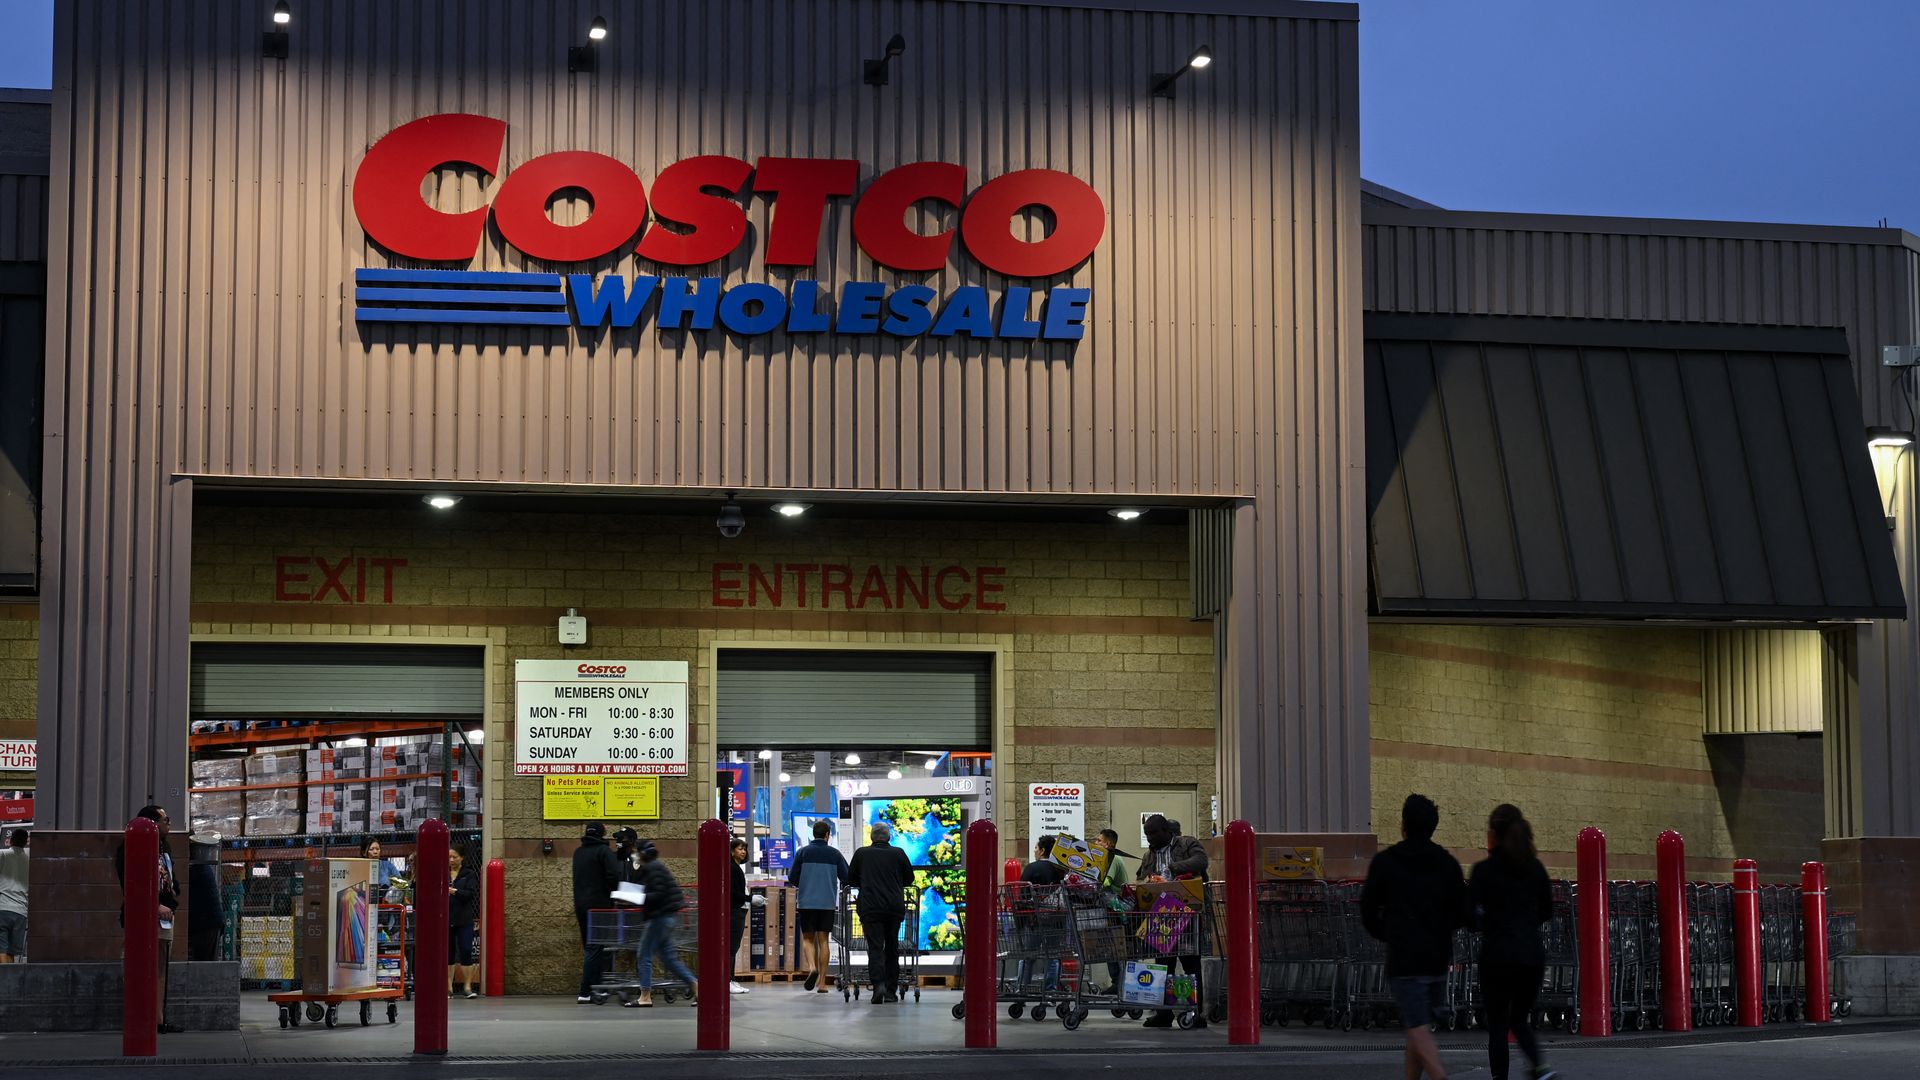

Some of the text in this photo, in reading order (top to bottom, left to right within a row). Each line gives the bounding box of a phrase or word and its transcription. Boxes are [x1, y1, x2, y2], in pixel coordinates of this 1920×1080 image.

[353, 113, 1105, 277] COSTCO
[566, 274, 1091, 339] WHOLESALE
[275, 556, 408, 603] EXIT
[712, 562, 1006, 611] ENTRANCE
[578, 664, 627, 674] COSTCO
[554, 687, 649, 699] MEMBERS ONLY
[529, 706, 557, 718] MON
[568, 707, 587, 718] FRI
[608, 707, 639, 719] 10:00
[649, 707, 674, 719] 8:30
[529, 727, 592, 738] SATURDAY
[613, 727, 638, 739] 9:30
[648, 727, 674, 739] 6:00
[529, 747, 578, 759] SUNDAY
[607, 747, 638, 759] 10:00
[648, 747, 674, 759] 6:00
[517, 765, 686, 774] OPEN 24 HOURS A DAY AT WWW.COSTCO.COM
[943, 779, 973, 792] OLED
[985, 780, 991, 796] LG
[1033, 786, 1080, 796] COSTCO
[1139, 974, 1151, 983] all
